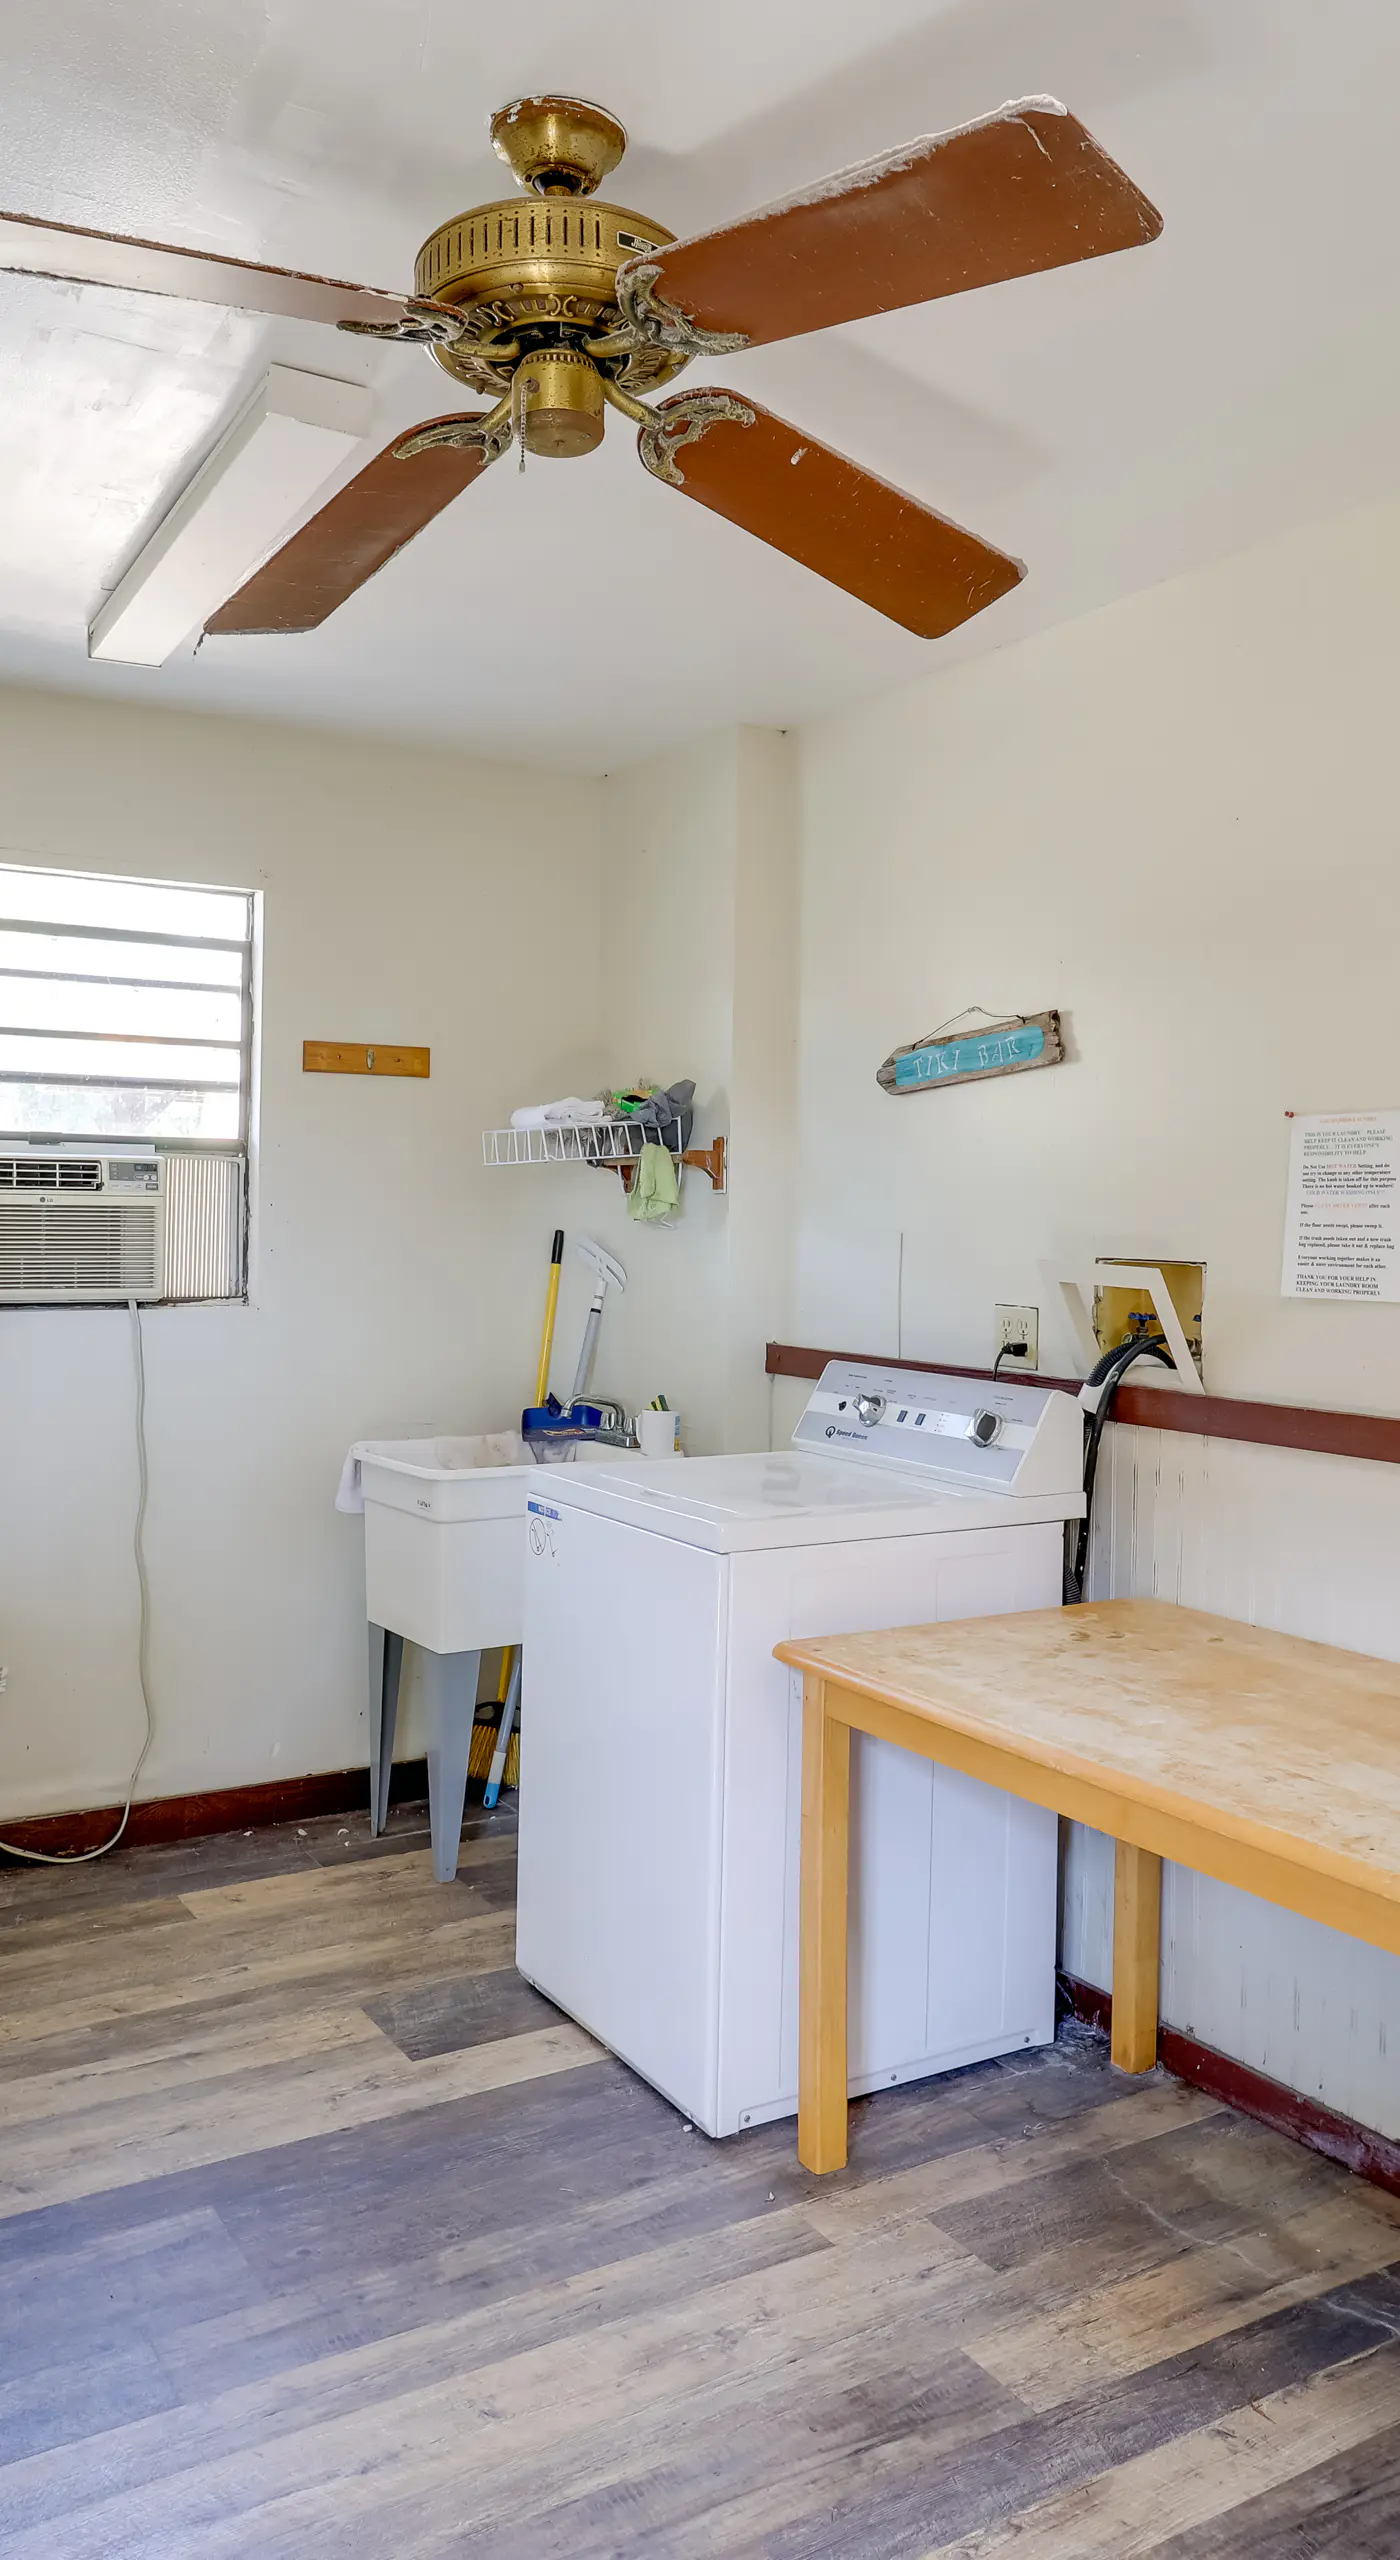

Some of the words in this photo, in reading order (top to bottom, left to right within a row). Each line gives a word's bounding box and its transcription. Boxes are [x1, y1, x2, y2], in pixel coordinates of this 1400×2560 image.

[913, 1050, 960, 1079] TIKI
[978, 1036, 1020, 1067] BAR
[836, 1429, 852, 1437] Speed
[852, 1432, 868, 1440] Queen
